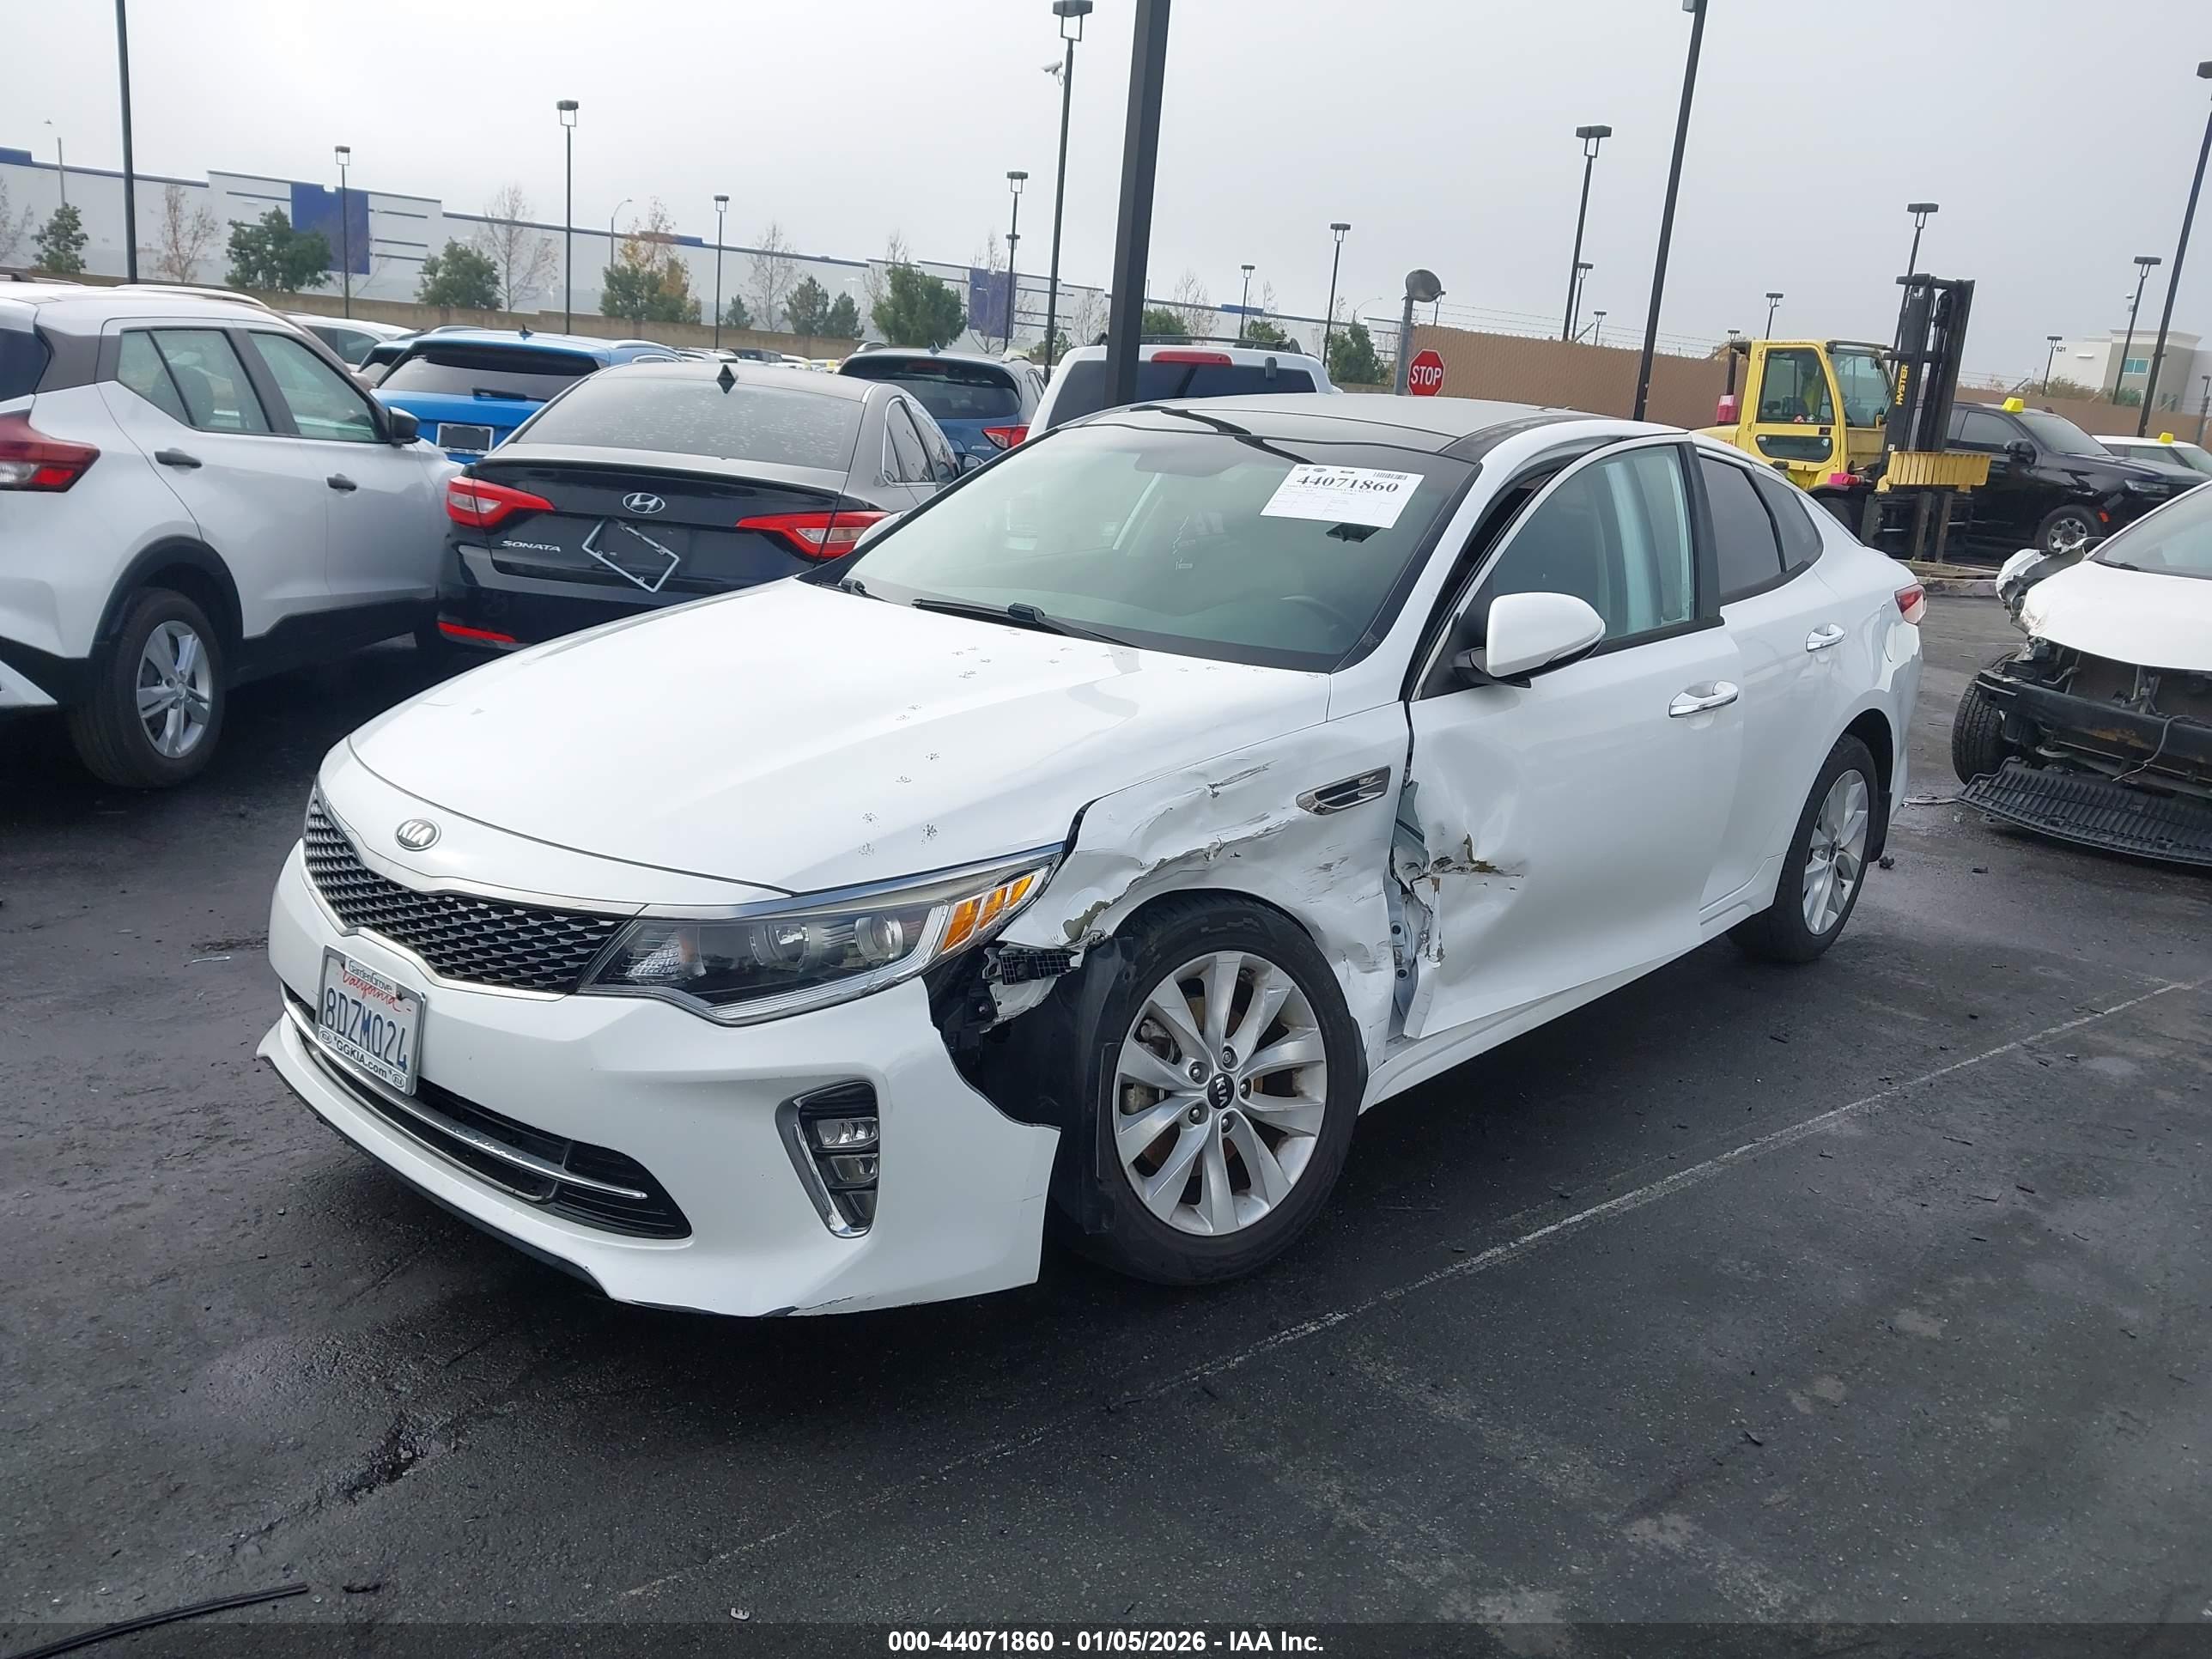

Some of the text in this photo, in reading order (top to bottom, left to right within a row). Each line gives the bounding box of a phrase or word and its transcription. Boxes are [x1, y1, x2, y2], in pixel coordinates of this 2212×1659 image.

[1411, 365, 1443, 386] STOP
[1895, 364, 1909, 405] HYSTER
[1296, 474, 1400, 493] 44071860
[501, 539, 562, 553] SONATA
[398, 820, 433, 846] KIA
[325, 987, 408, 1074] 8DZM024
[1215, 1076, 1228, 1107] KIA
